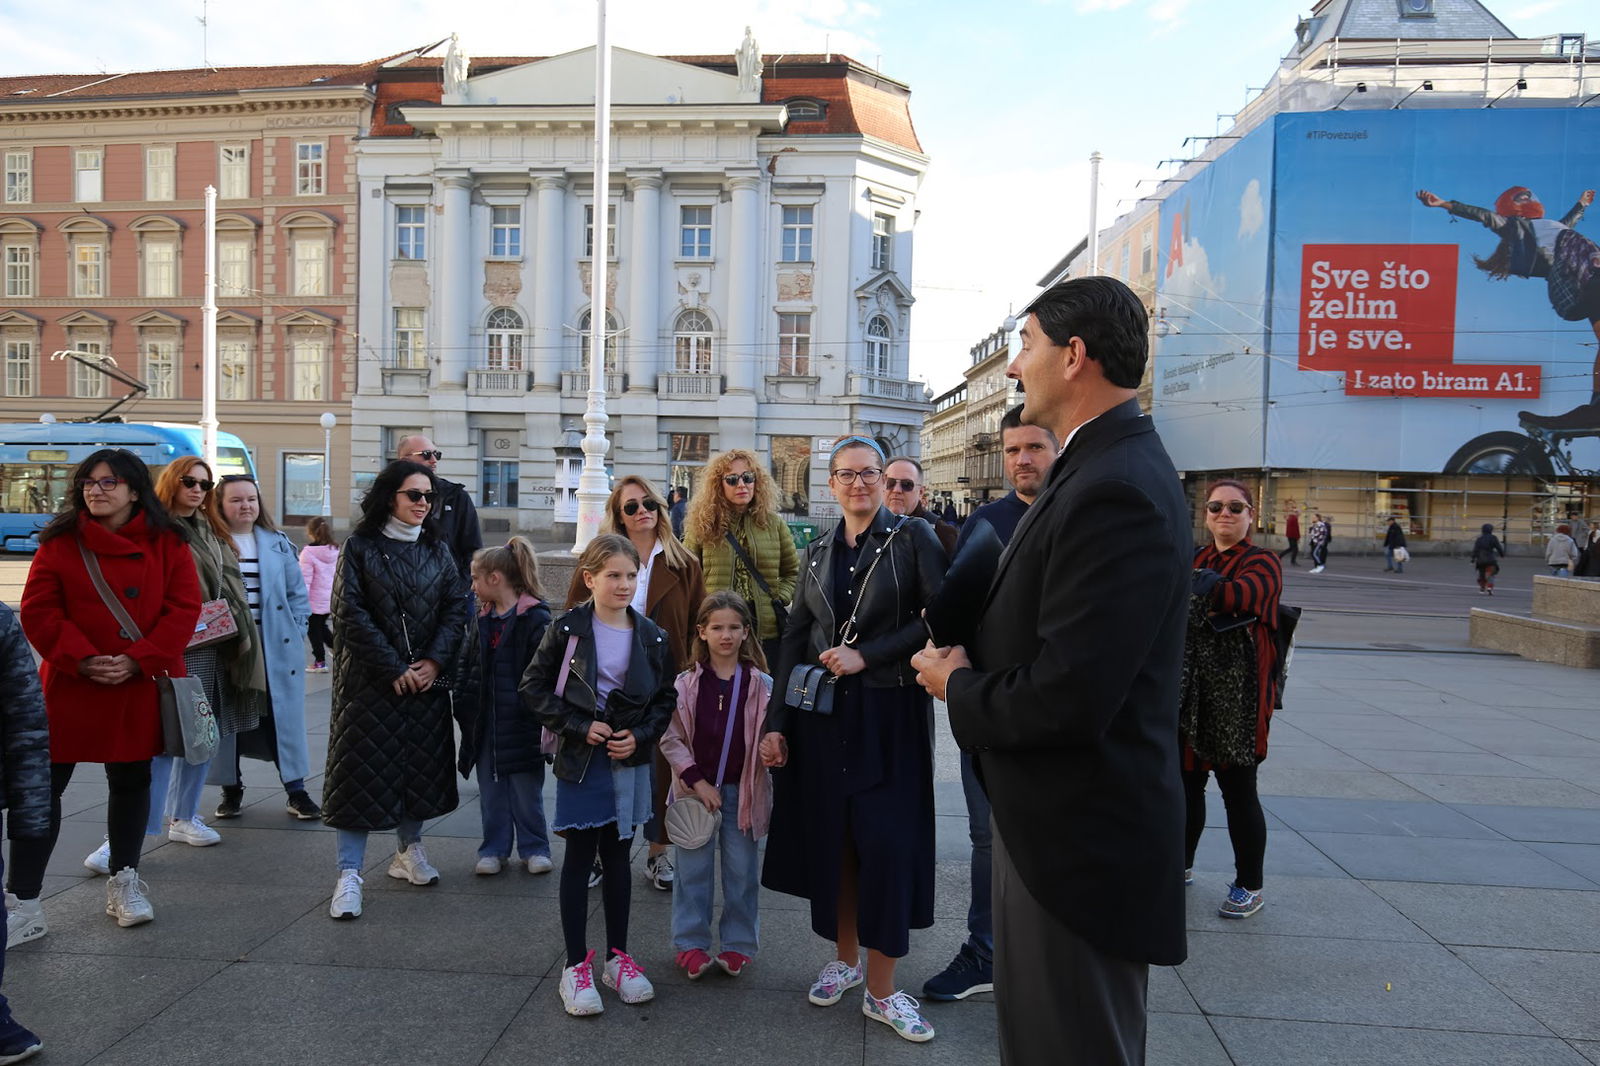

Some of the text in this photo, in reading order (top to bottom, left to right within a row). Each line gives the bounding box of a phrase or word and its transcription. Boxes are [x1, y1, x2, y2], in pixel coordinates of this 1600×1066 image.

[1306, 130, 1369, 141] #TiPovezuješ
[1310, 261, 1430, 289] Sve što
[1308, 291, 1398, 319] želim
[1307, 323, 1412, 356] je sve.
[1353, 370, 1533, 392] I zato biram A1.
